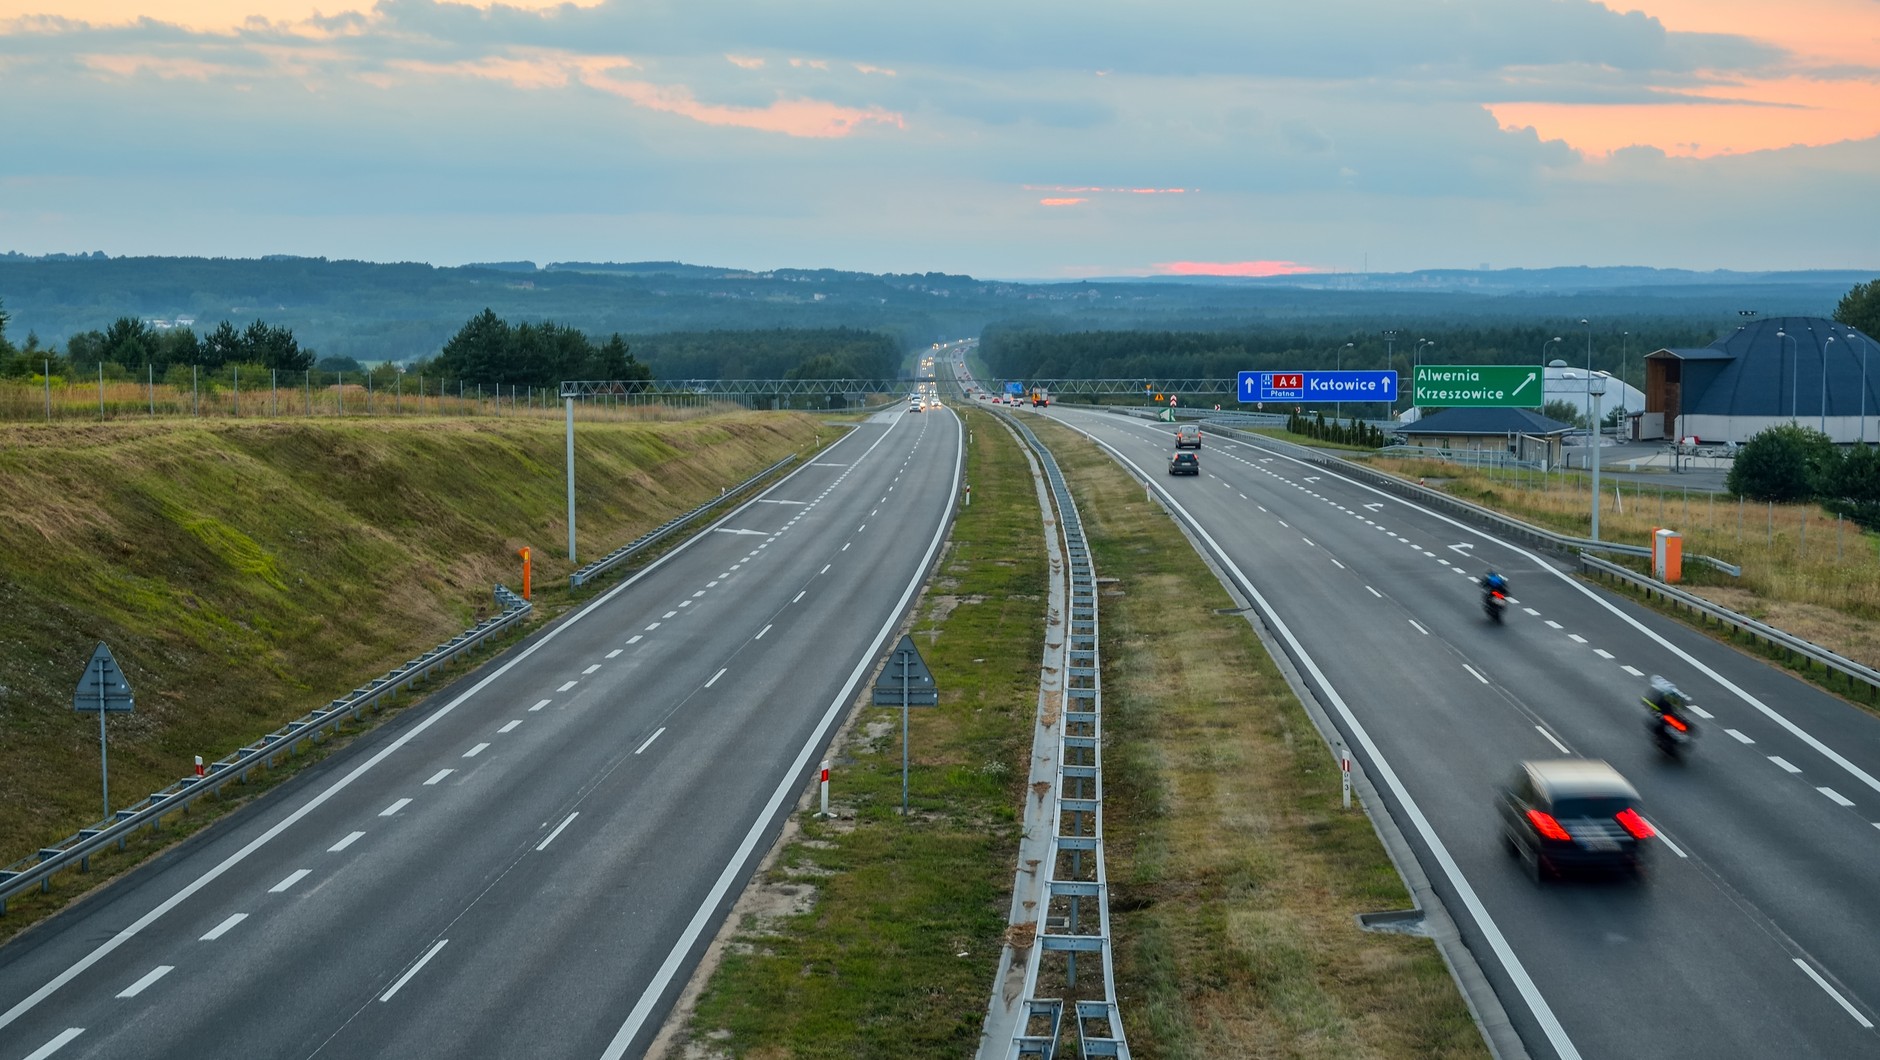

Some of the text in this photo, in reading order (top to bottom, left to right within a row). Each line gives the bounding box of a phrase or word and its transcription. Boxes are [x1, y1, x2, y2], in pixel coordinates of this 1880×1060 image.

[1417, 368, 1480, 381] Alwernia
[1310, 377, 1376, 391] Katowice
[1416, 386, 1504, 399] Krzeszowice
